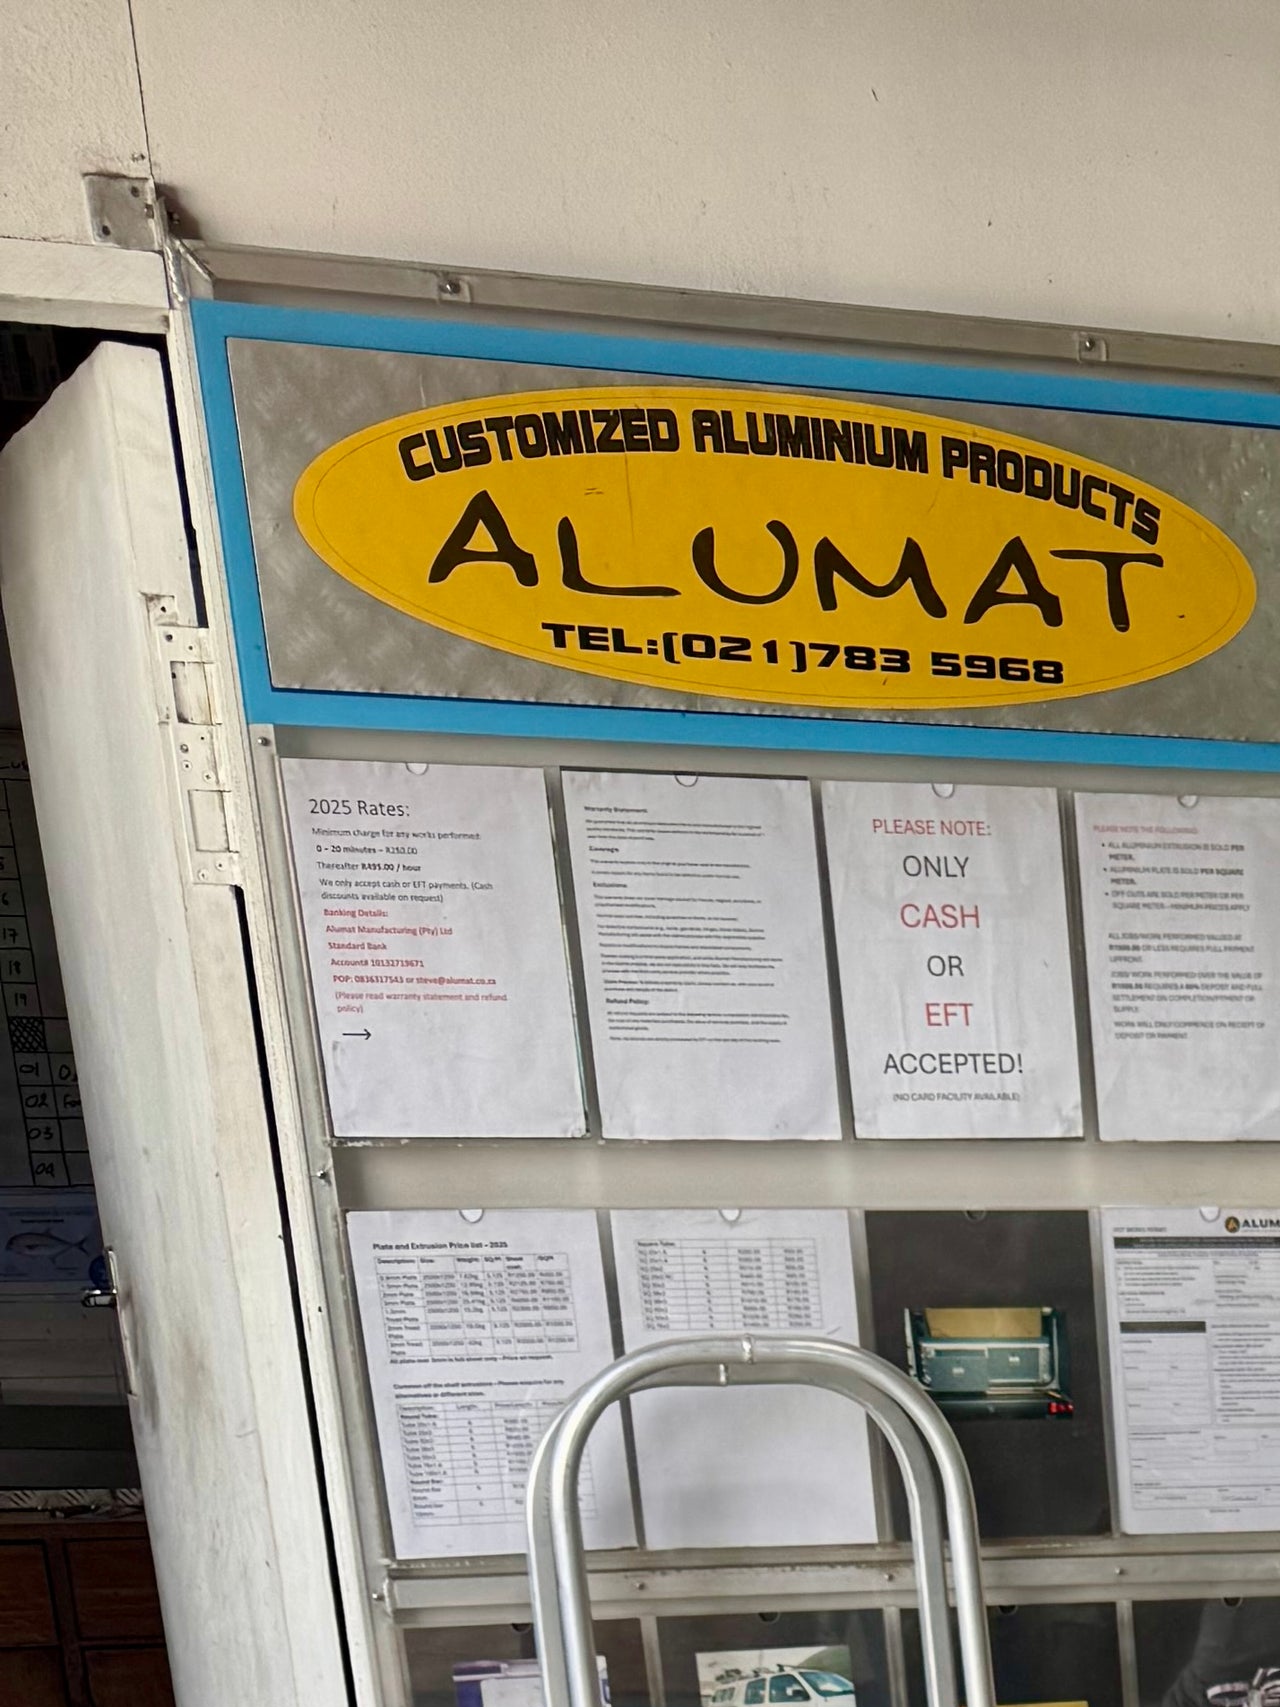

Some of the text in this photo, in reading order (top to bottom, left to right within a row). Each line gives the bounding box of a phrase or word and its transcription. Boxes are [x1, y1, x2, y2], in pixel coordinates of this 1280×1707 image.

[398, 406, 1165, 546] CUSTOMIZED ALUMINIUM PRODUCTS
[427, 490, 1166, 634] ALUMAT
[541, 622, 1066, 687] TEL:(021)783 5968
[309, 799, 410, 817] 2025 Rates:
[873, 819, 991, 836] PLEASE NOTE:
[317, 861, 358, 870] Thereafter
[903, 856, 969, 878] ONLY
[319, 878, 333, 886] We
[335, 879, 352, 888] only
[355, 880, 380, 888] accept
[383, 880, 400, 888] cash
[472, 882, 493, 891] (Cash
[321, 892, 359, 900] discounts
[362, 892, 395, 901] available
[411, 895, 443, 903] request)
[324, 909, 388, 918] Banking Details:
[901, 904, 980, 928] CASH
[3, 928, 18, 944] 17
[326, 926, 355, 934] Alumat
[358, 926, 417, 936] Manufacturing
[419, 927, 438, 936] (Pty)
[328, 942, 365, 950] Standard
[927, 955, 964, 976] OR
[14, 992, 27, 1007] 19
[925, 1002, 974, 1026] EFT
[884, 1053, 1023, 1074] ACCEPTED!
[25, 1093, 48, 1108] 02
